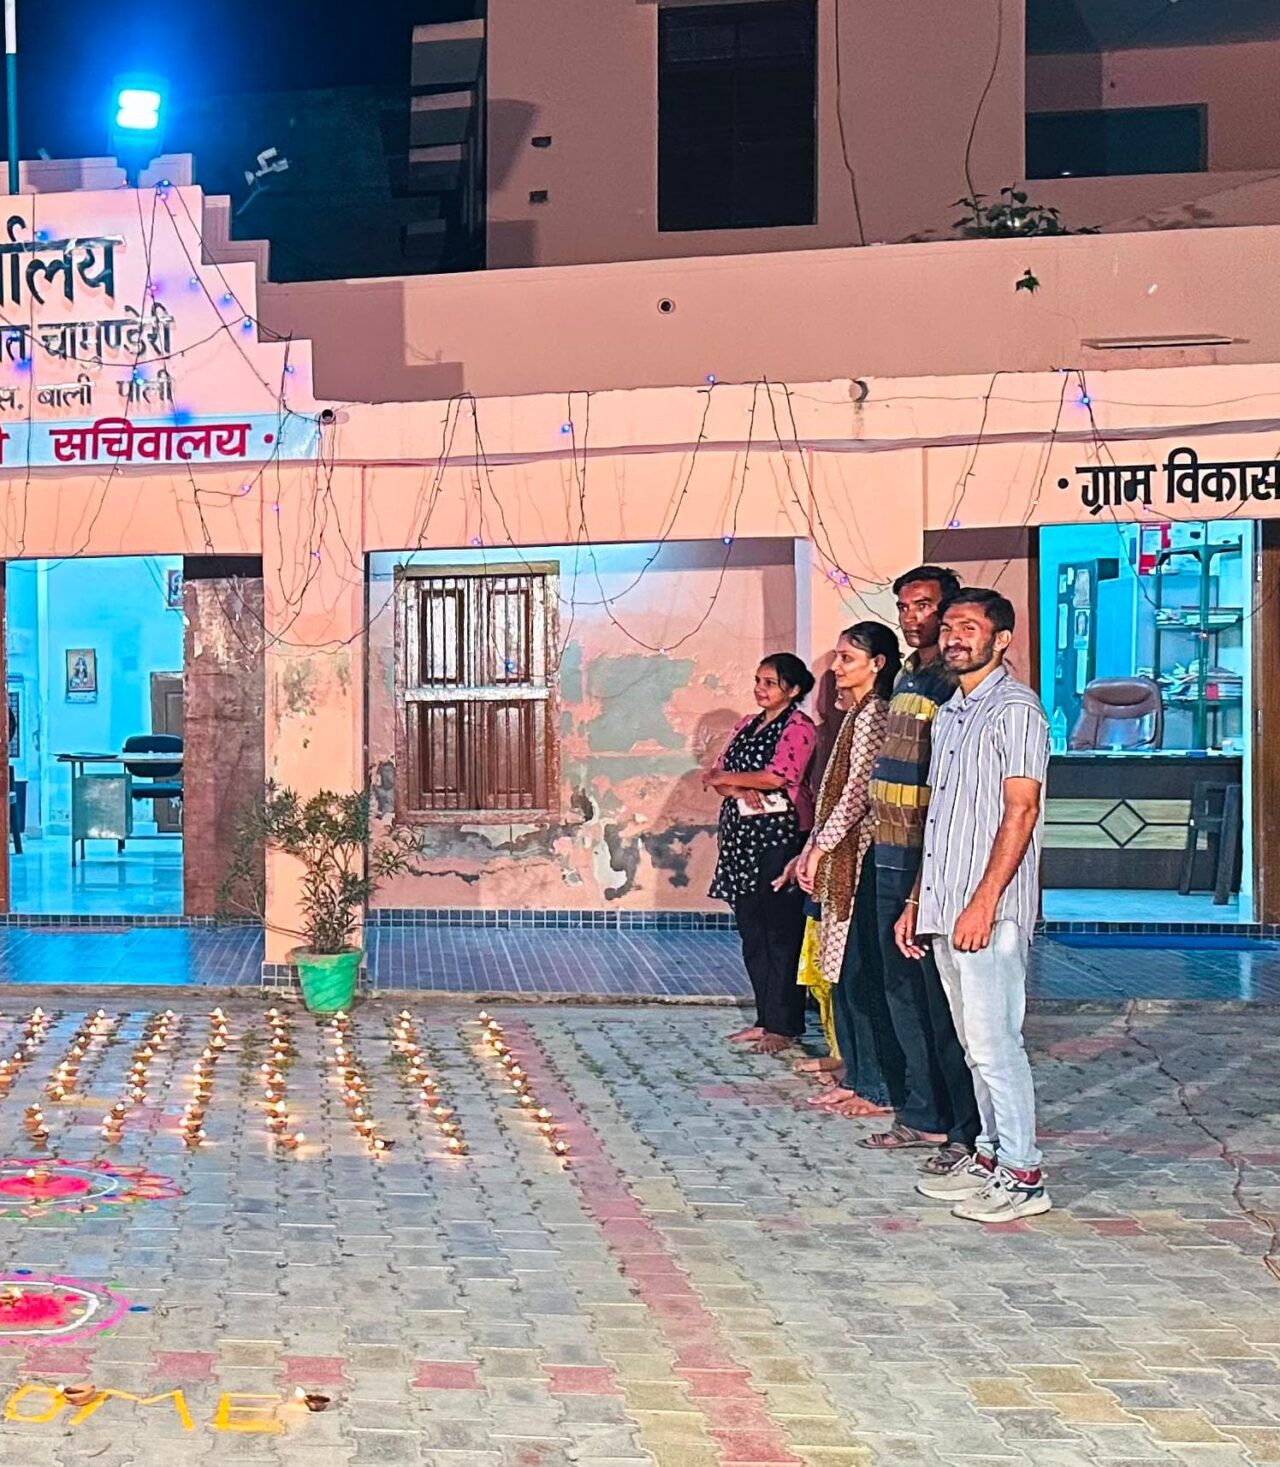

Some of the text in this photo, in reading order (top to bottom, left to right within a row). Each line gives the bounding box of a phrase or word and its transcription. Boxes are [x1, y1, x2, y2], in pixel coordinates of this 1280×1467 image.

[35, 373, 95, 407] बाली
[49, 417, 252, 461] सचिवालय
[1075, 464, 1157, 515] ग्राम
